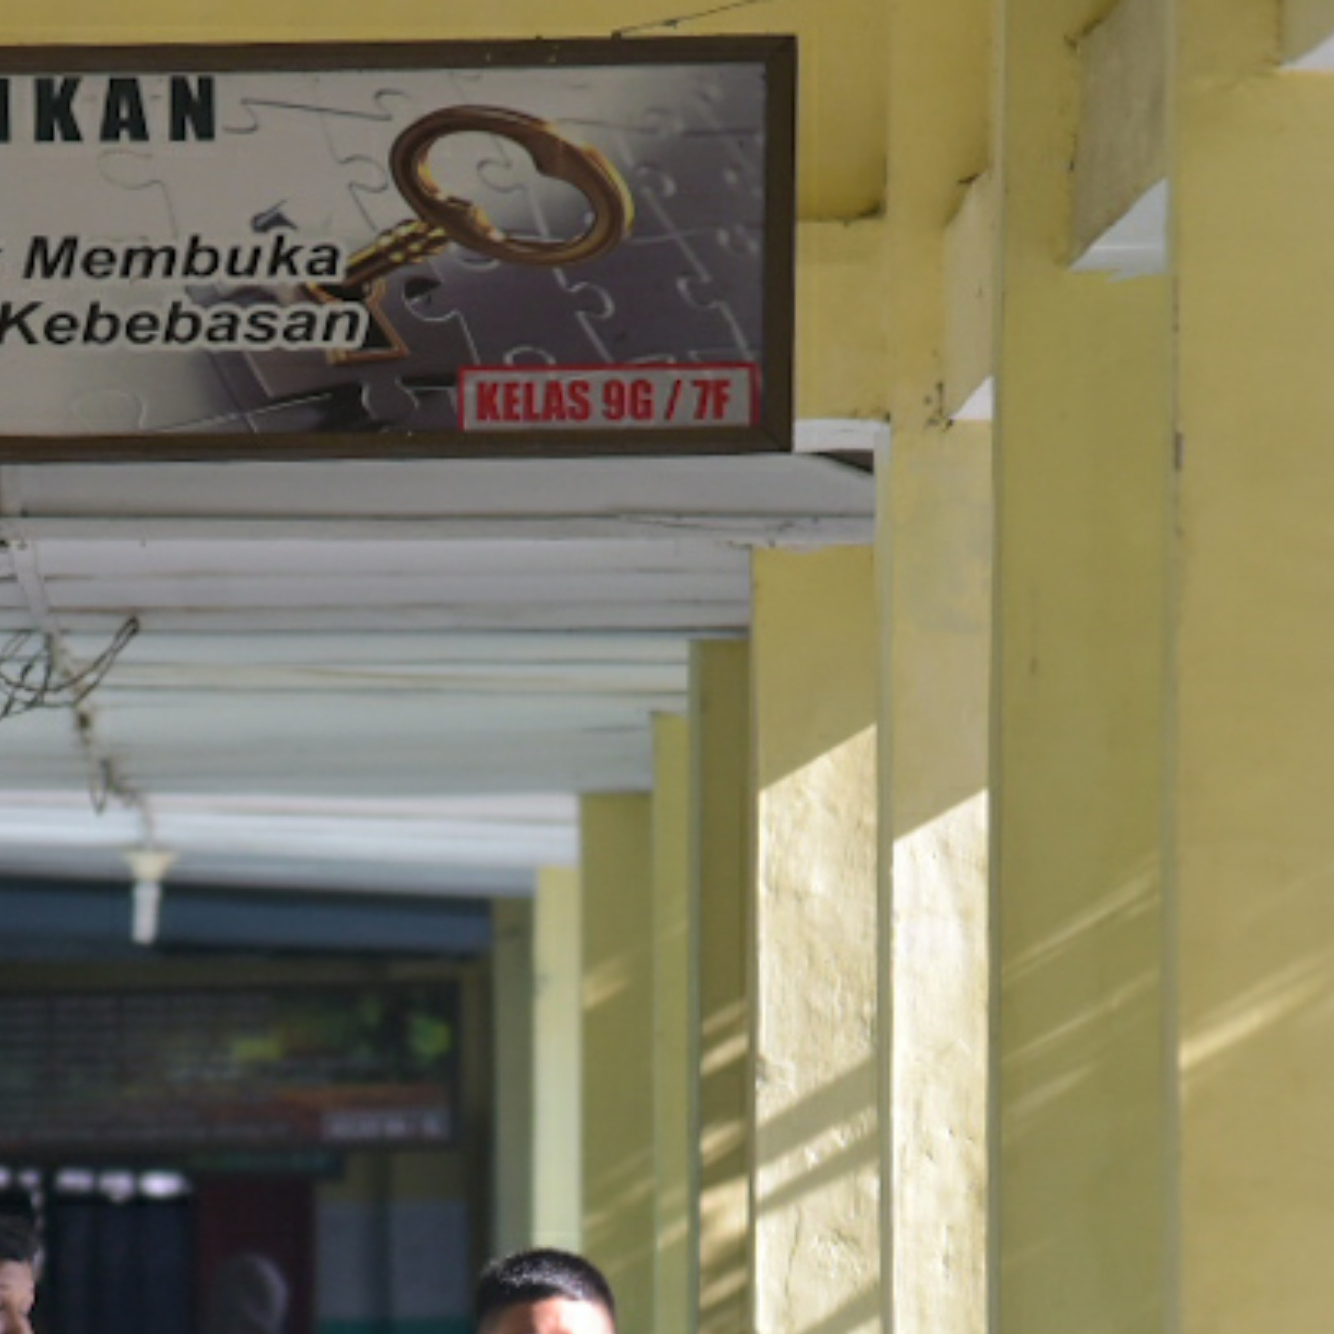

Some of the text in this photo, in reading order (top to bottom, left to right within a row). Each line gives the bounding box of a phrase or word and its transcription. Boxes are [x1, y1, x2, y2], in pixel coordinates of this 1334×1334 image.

[23, 235, 340, 281] Membuka
[476, 379, 730, 421] KELAS 9G / 7F
